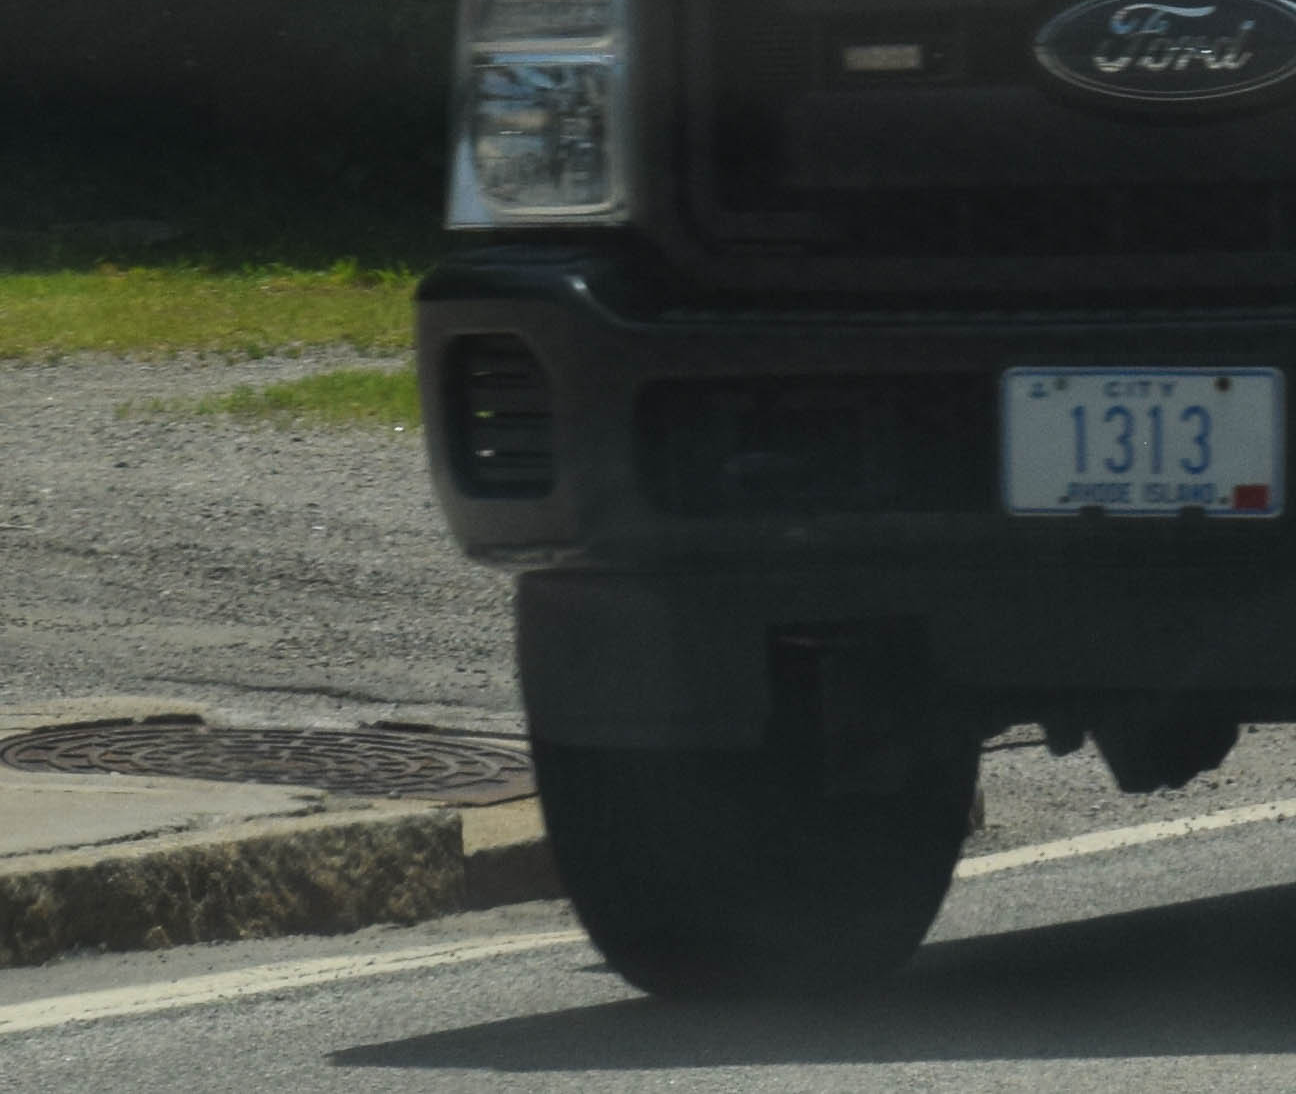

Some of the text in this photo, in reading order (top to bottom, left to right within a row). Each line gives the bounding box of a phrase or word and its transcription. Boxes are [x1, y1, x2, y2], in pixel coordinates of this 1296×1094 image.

[1092, 3, 1257, 72] Ford
[1104, 381, 1175, 396] CITY
[1071, 404, 1213, 474] 1313
